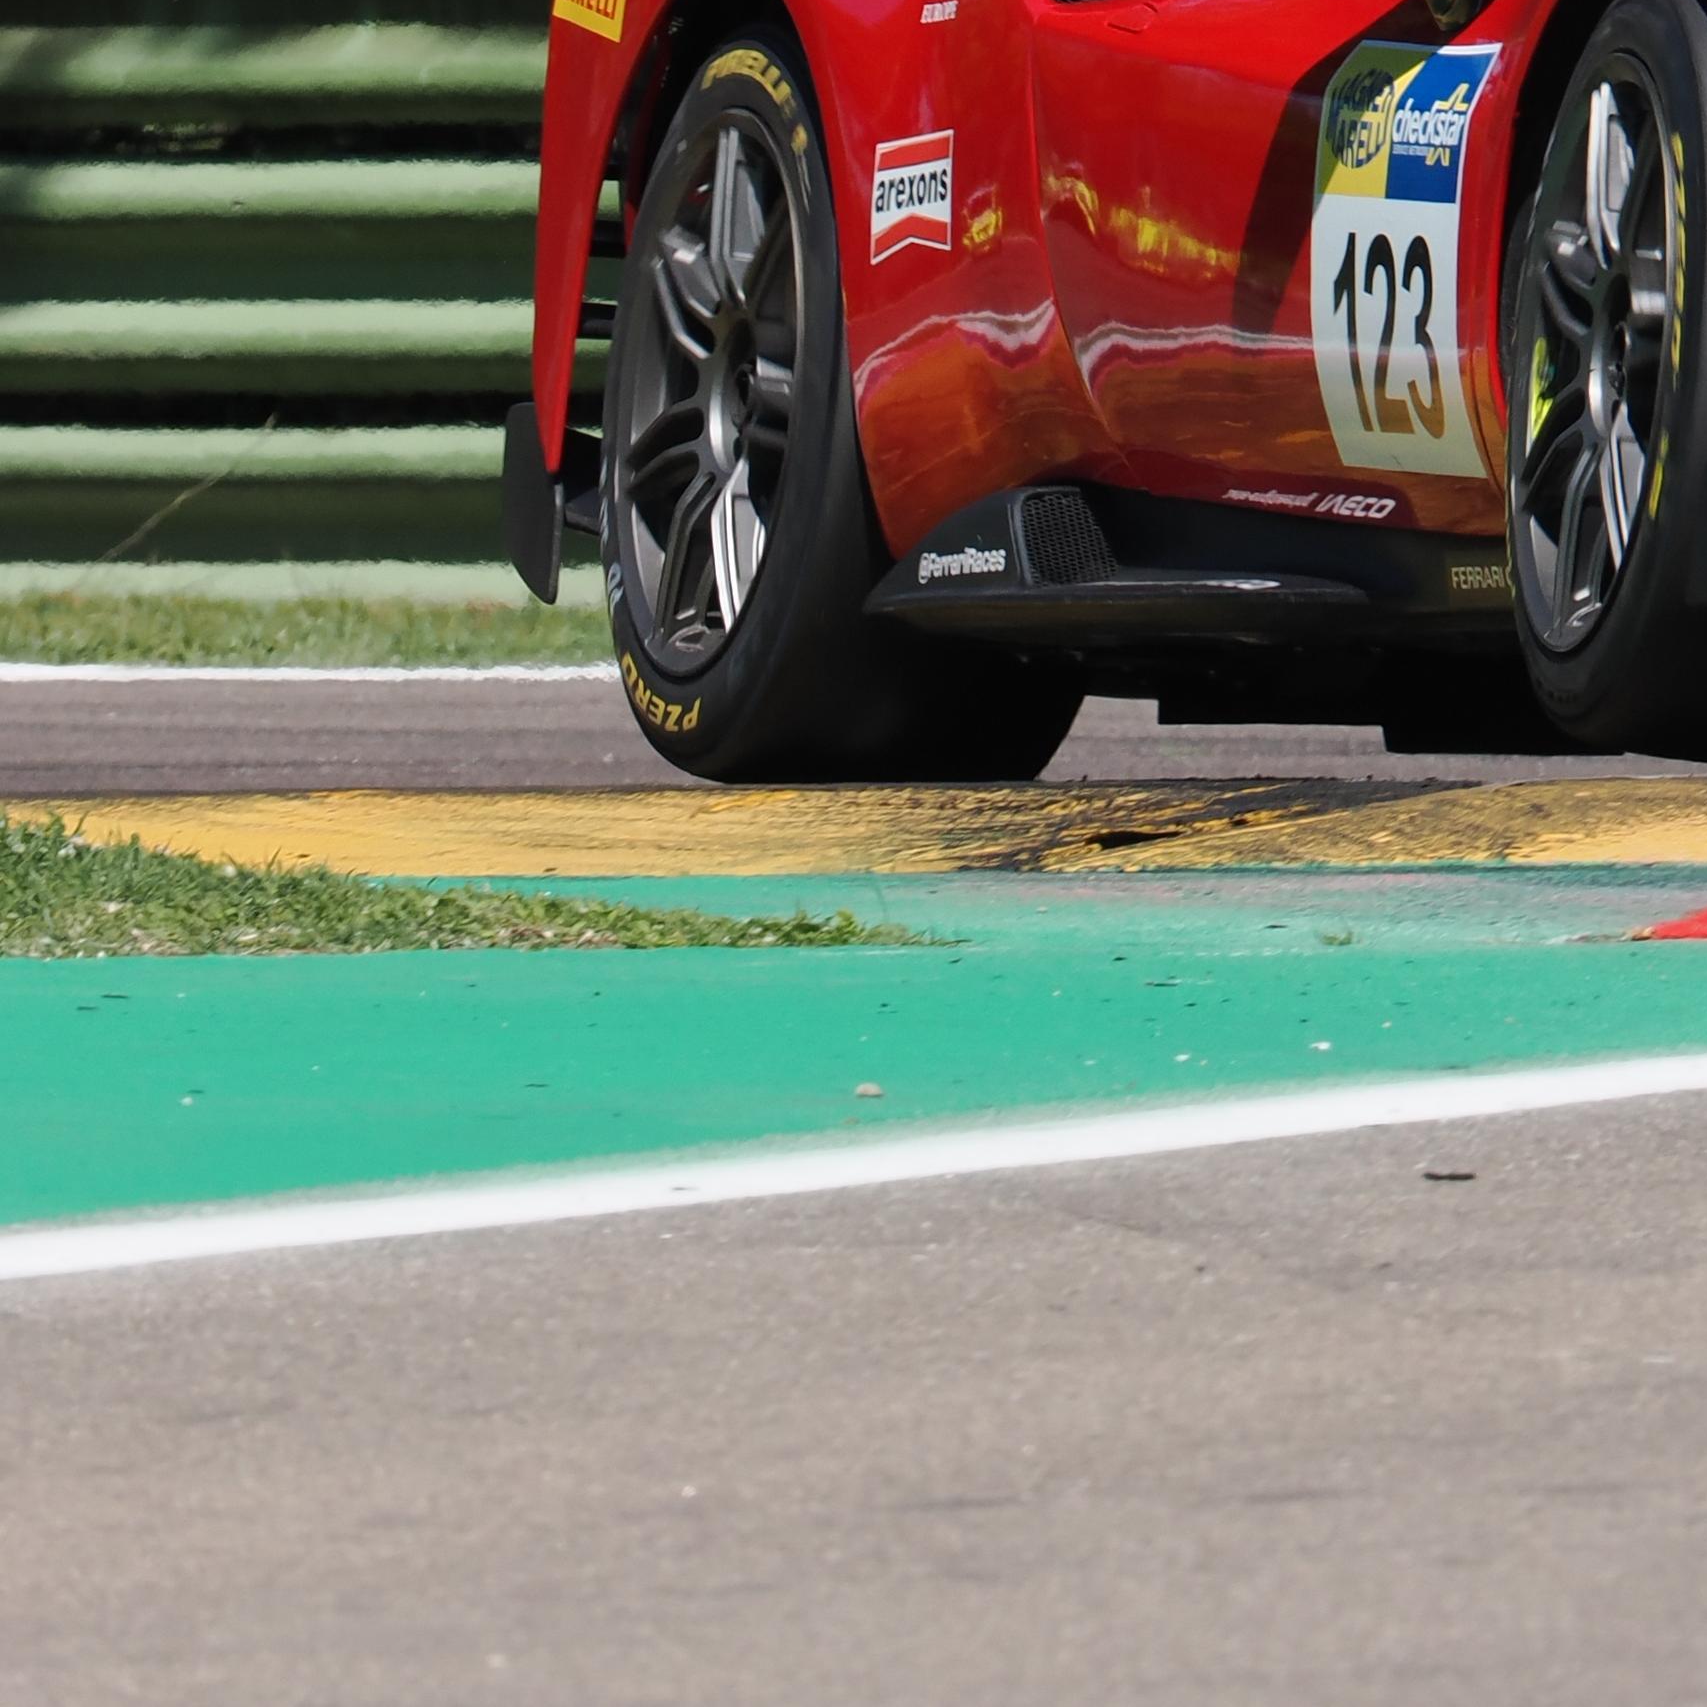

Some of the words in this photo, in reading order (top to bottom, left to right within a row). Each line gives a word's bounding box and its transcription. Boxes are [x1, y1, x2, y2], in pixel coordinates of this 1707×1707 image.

[1392, 97, 1467, 146] checkstar
[875, 168, 948, 213] arexons
[1333, 231, 1446, 440] 123
[1451, 566, 1506, 590] FERRARI
